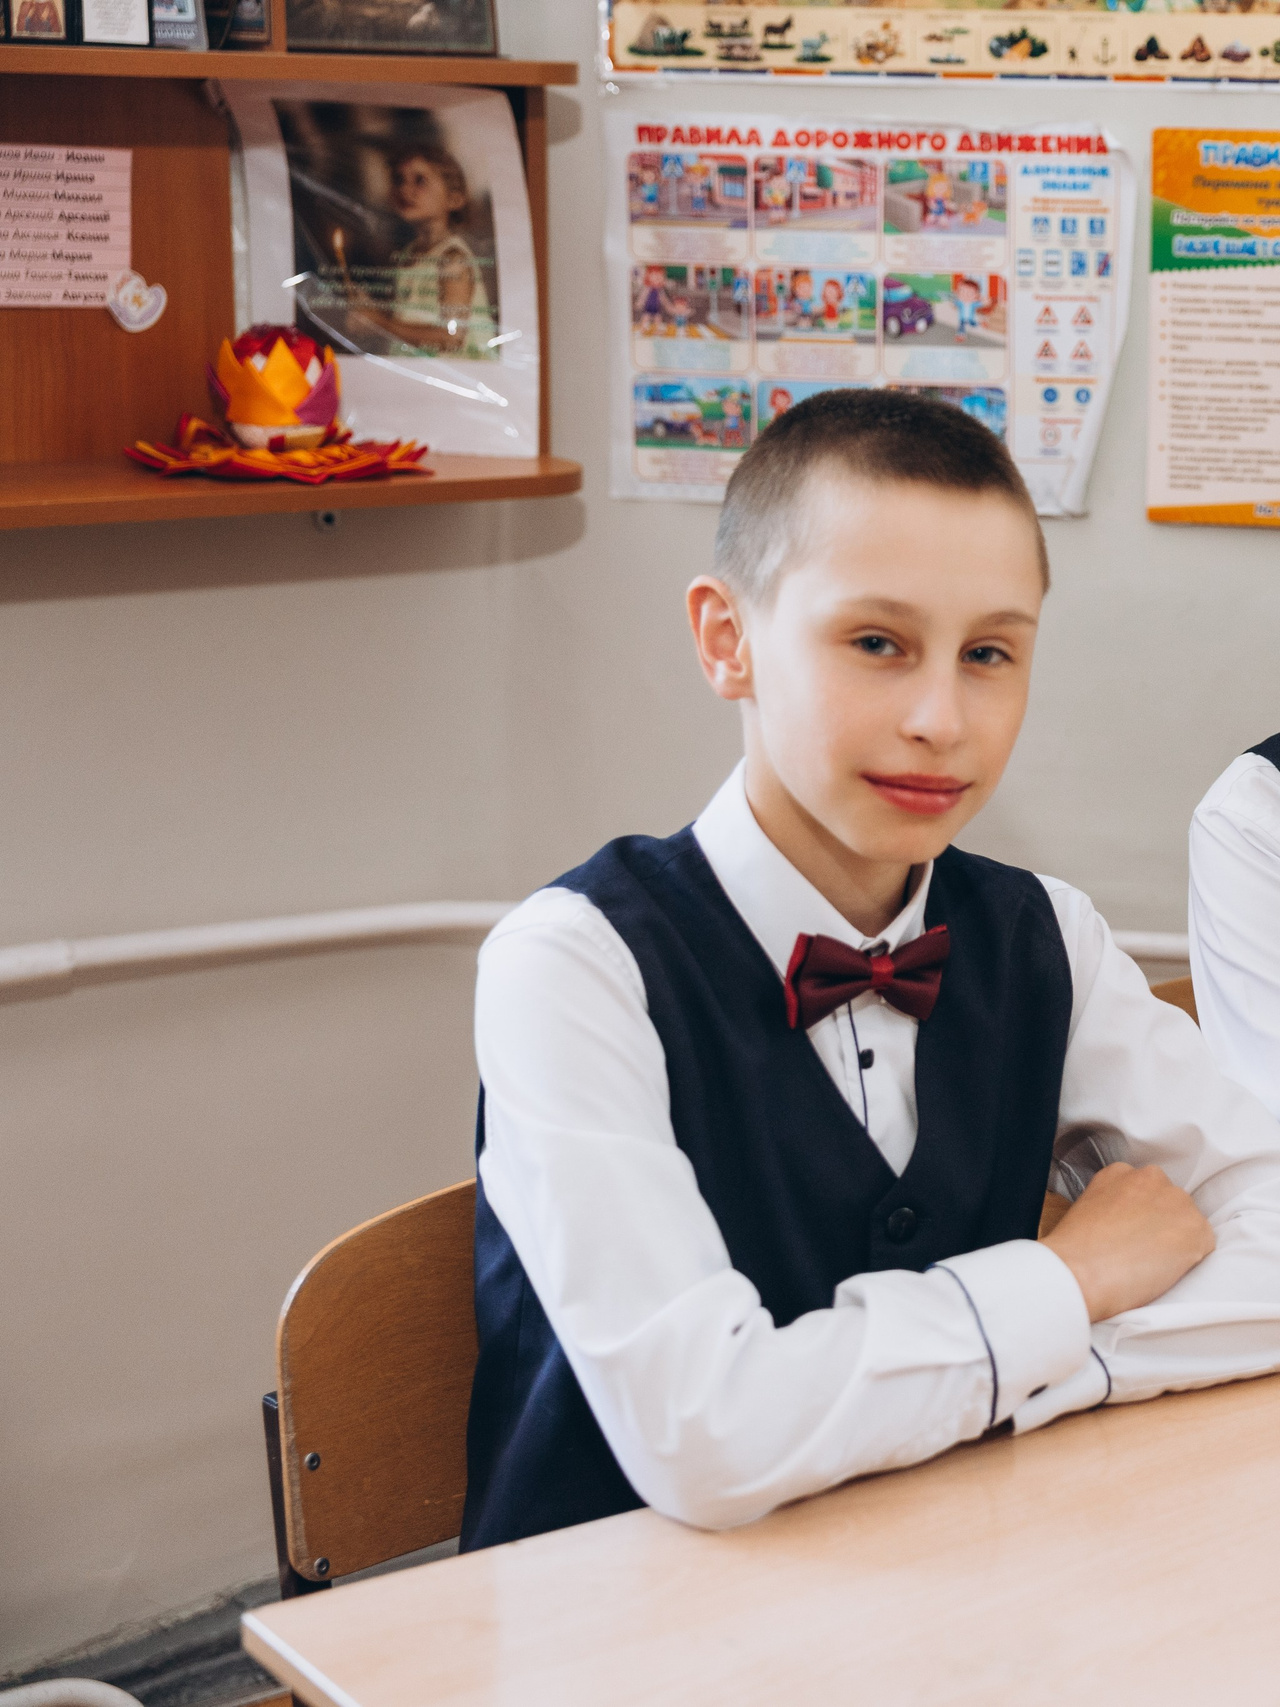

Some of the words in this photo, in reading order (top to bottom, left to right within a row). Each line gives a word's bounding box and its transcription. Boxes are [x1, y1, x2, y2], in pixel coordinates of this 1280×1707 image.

[636, 124, 761, 146] ПРАВИЛА
[771, 128, 946, 151] ДОРОЖНОГО
[957, 131, 1108, 154] ДВИЖЕНИЯ
